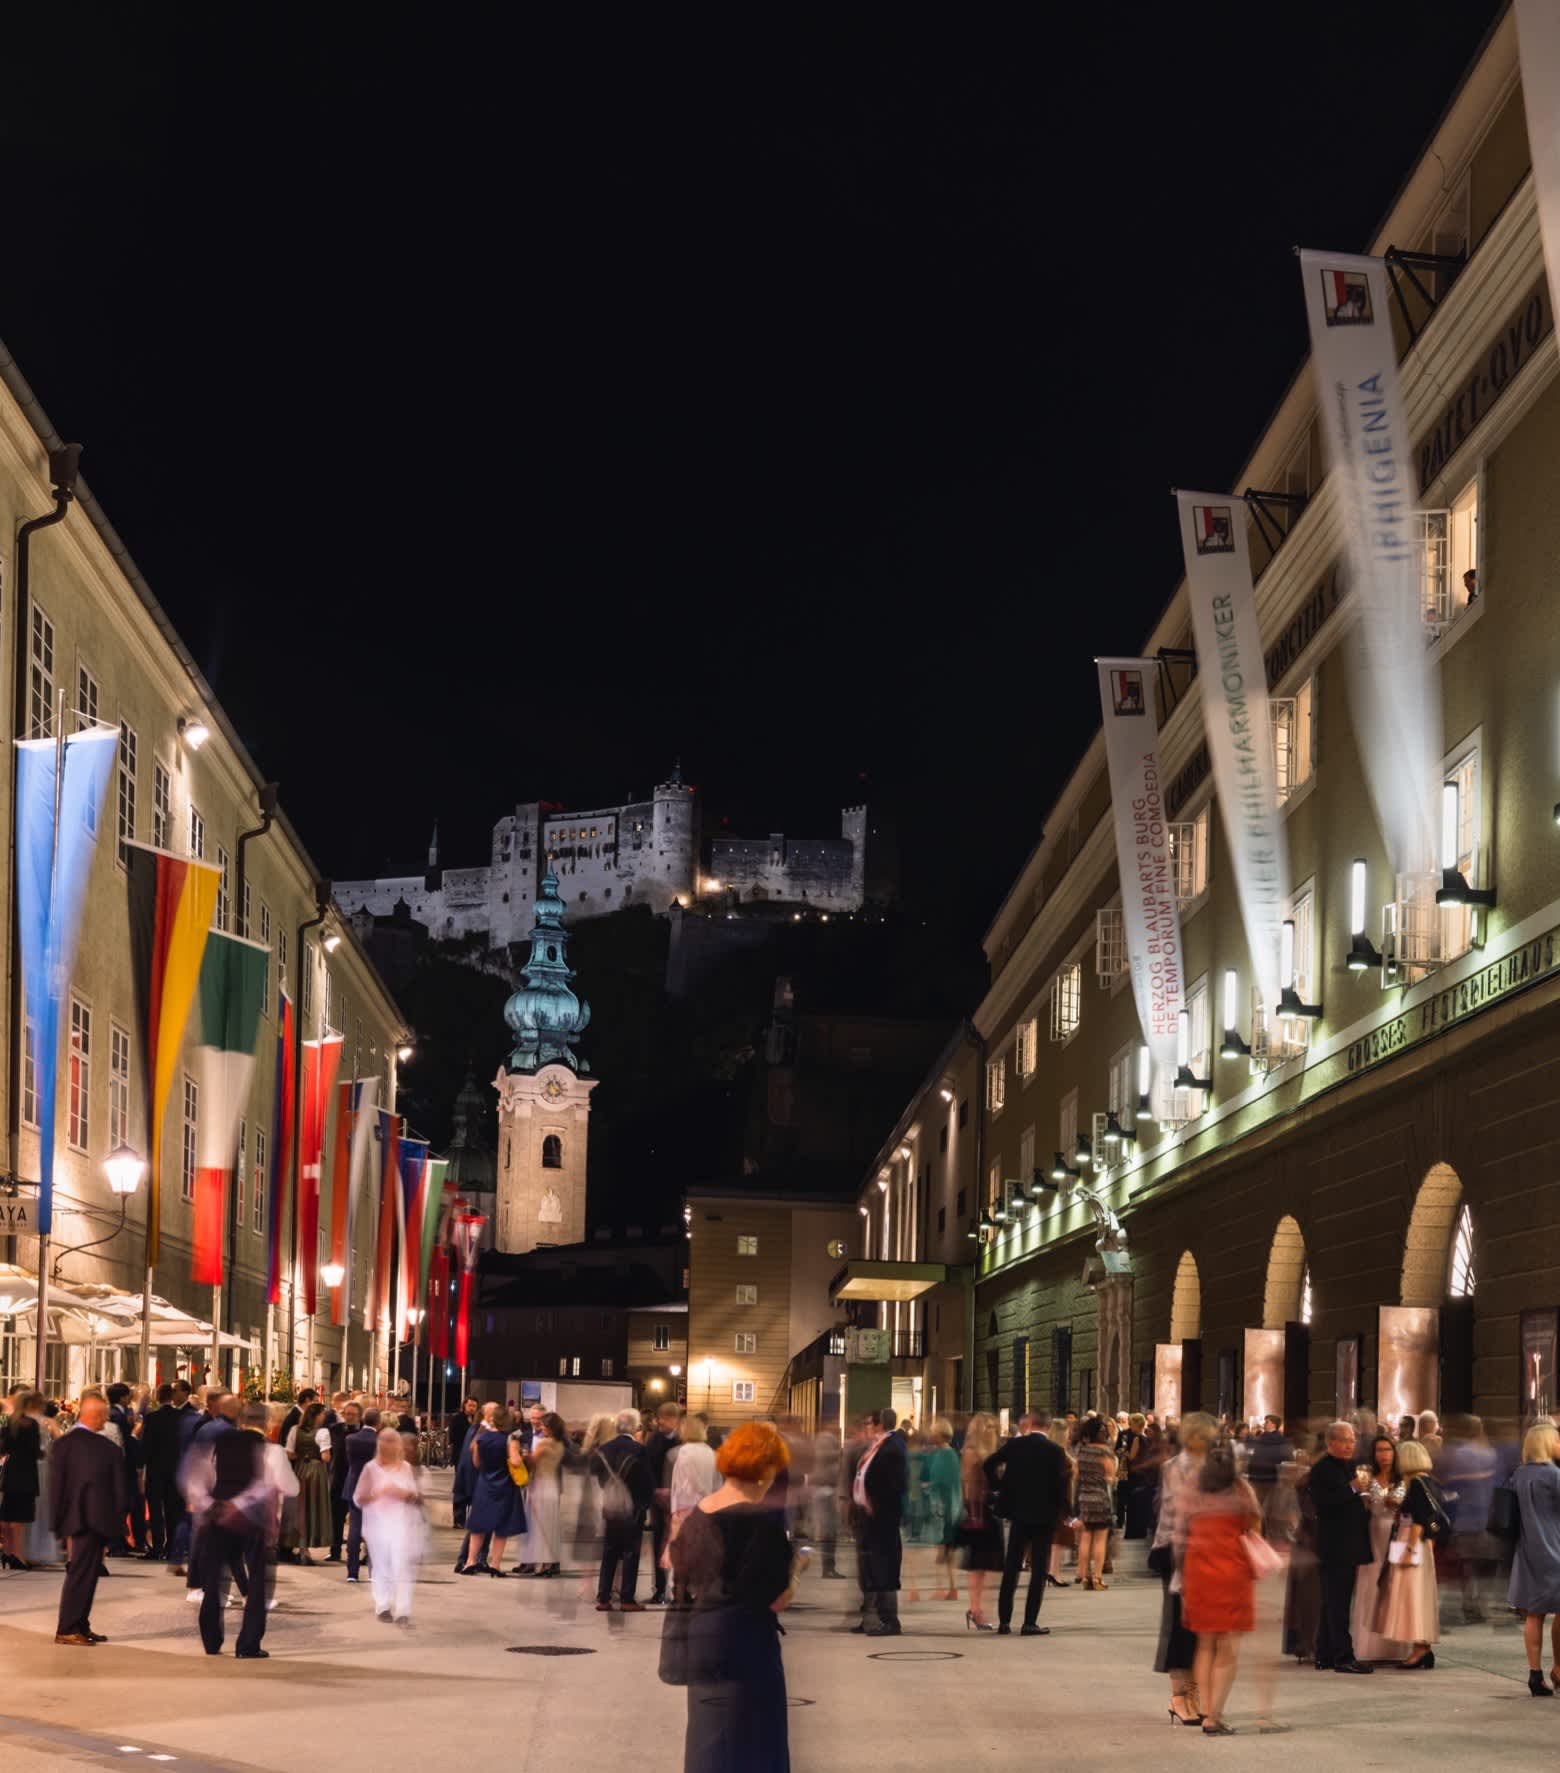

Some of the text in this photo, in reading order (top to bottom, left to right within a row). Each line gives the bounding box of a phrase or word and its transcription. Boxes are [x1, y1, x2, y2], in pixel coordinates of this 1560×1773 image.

[1357, 372, 1410, 561] IPHIGENIA
[1211, 592, 1272, 838] PHILHARMONIKER
[1132, 797, 1149, 845] BURG
[1143, 751, 1180, 1034] DE TEMPORUM FINE COMOEDIA
[1137, 850, 1161, 955] BLAUBARTS
[1150, 961, 1166, 1035] HERZOG
